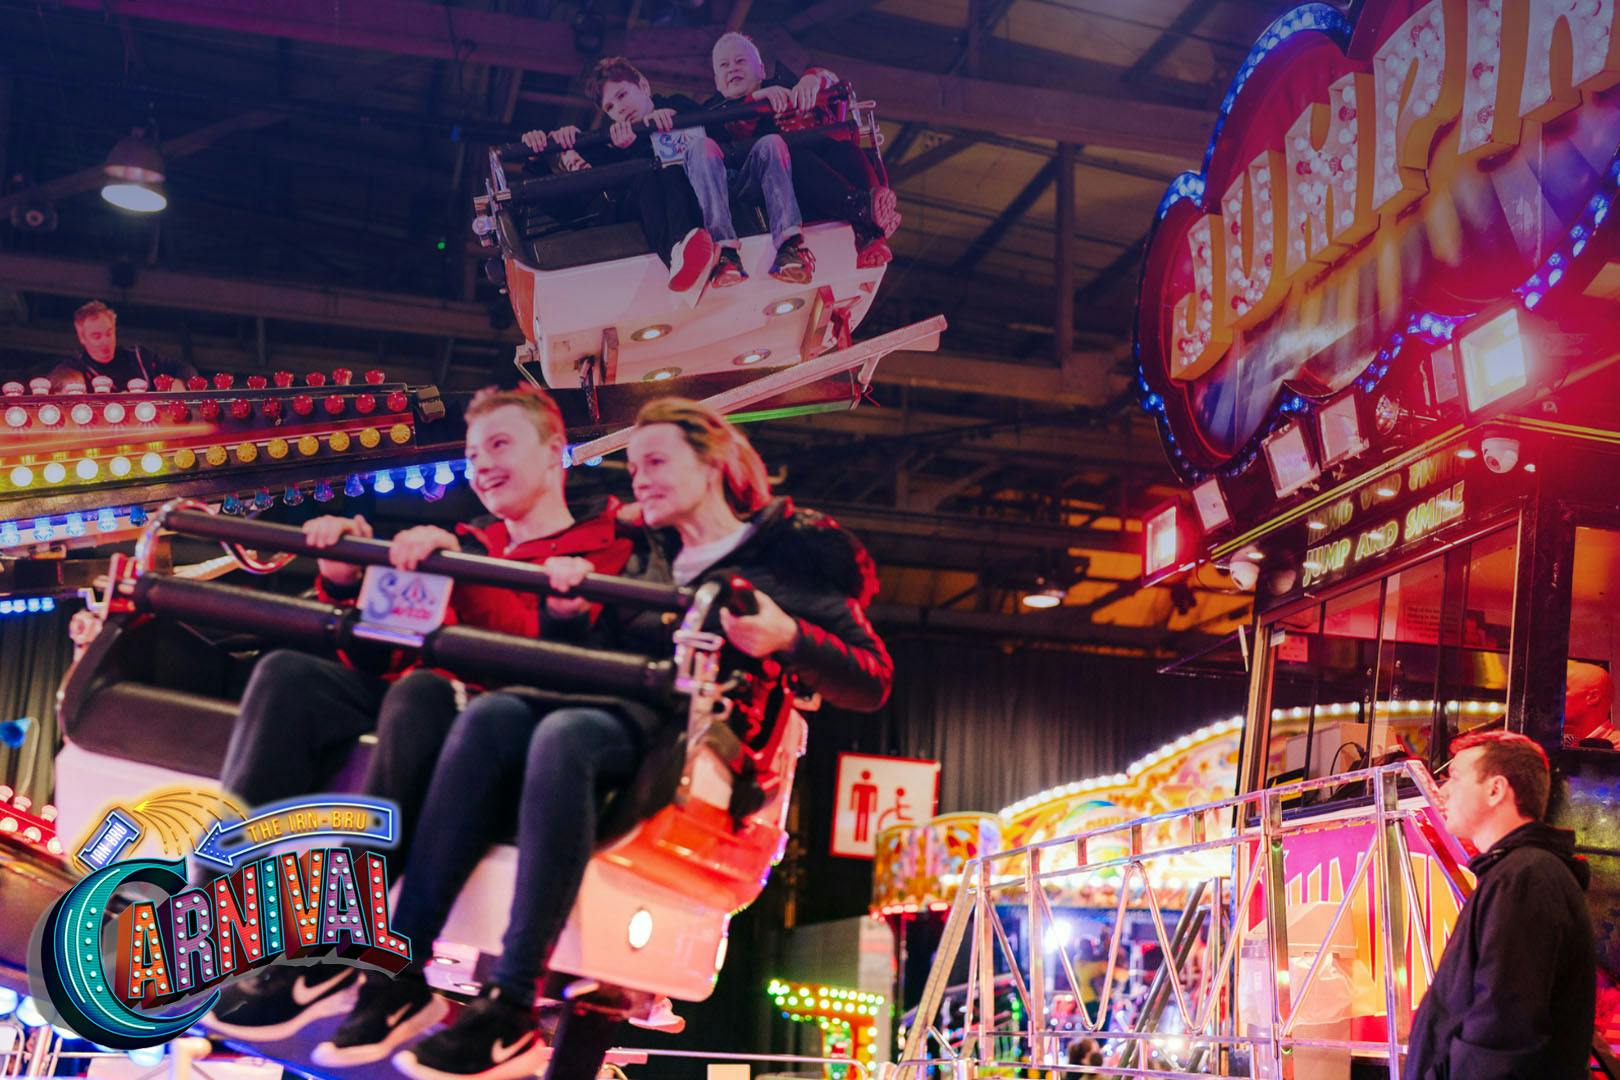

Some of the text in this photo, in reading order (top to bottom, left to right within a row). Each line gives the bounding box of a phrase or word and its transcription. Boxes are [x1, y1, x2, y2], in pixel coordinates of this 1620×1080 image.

[1302, 538, 1351, 588] JUMP
[1355, 520, 1399, 561] AND
[1404, 479, 1465, 541] SMILE
